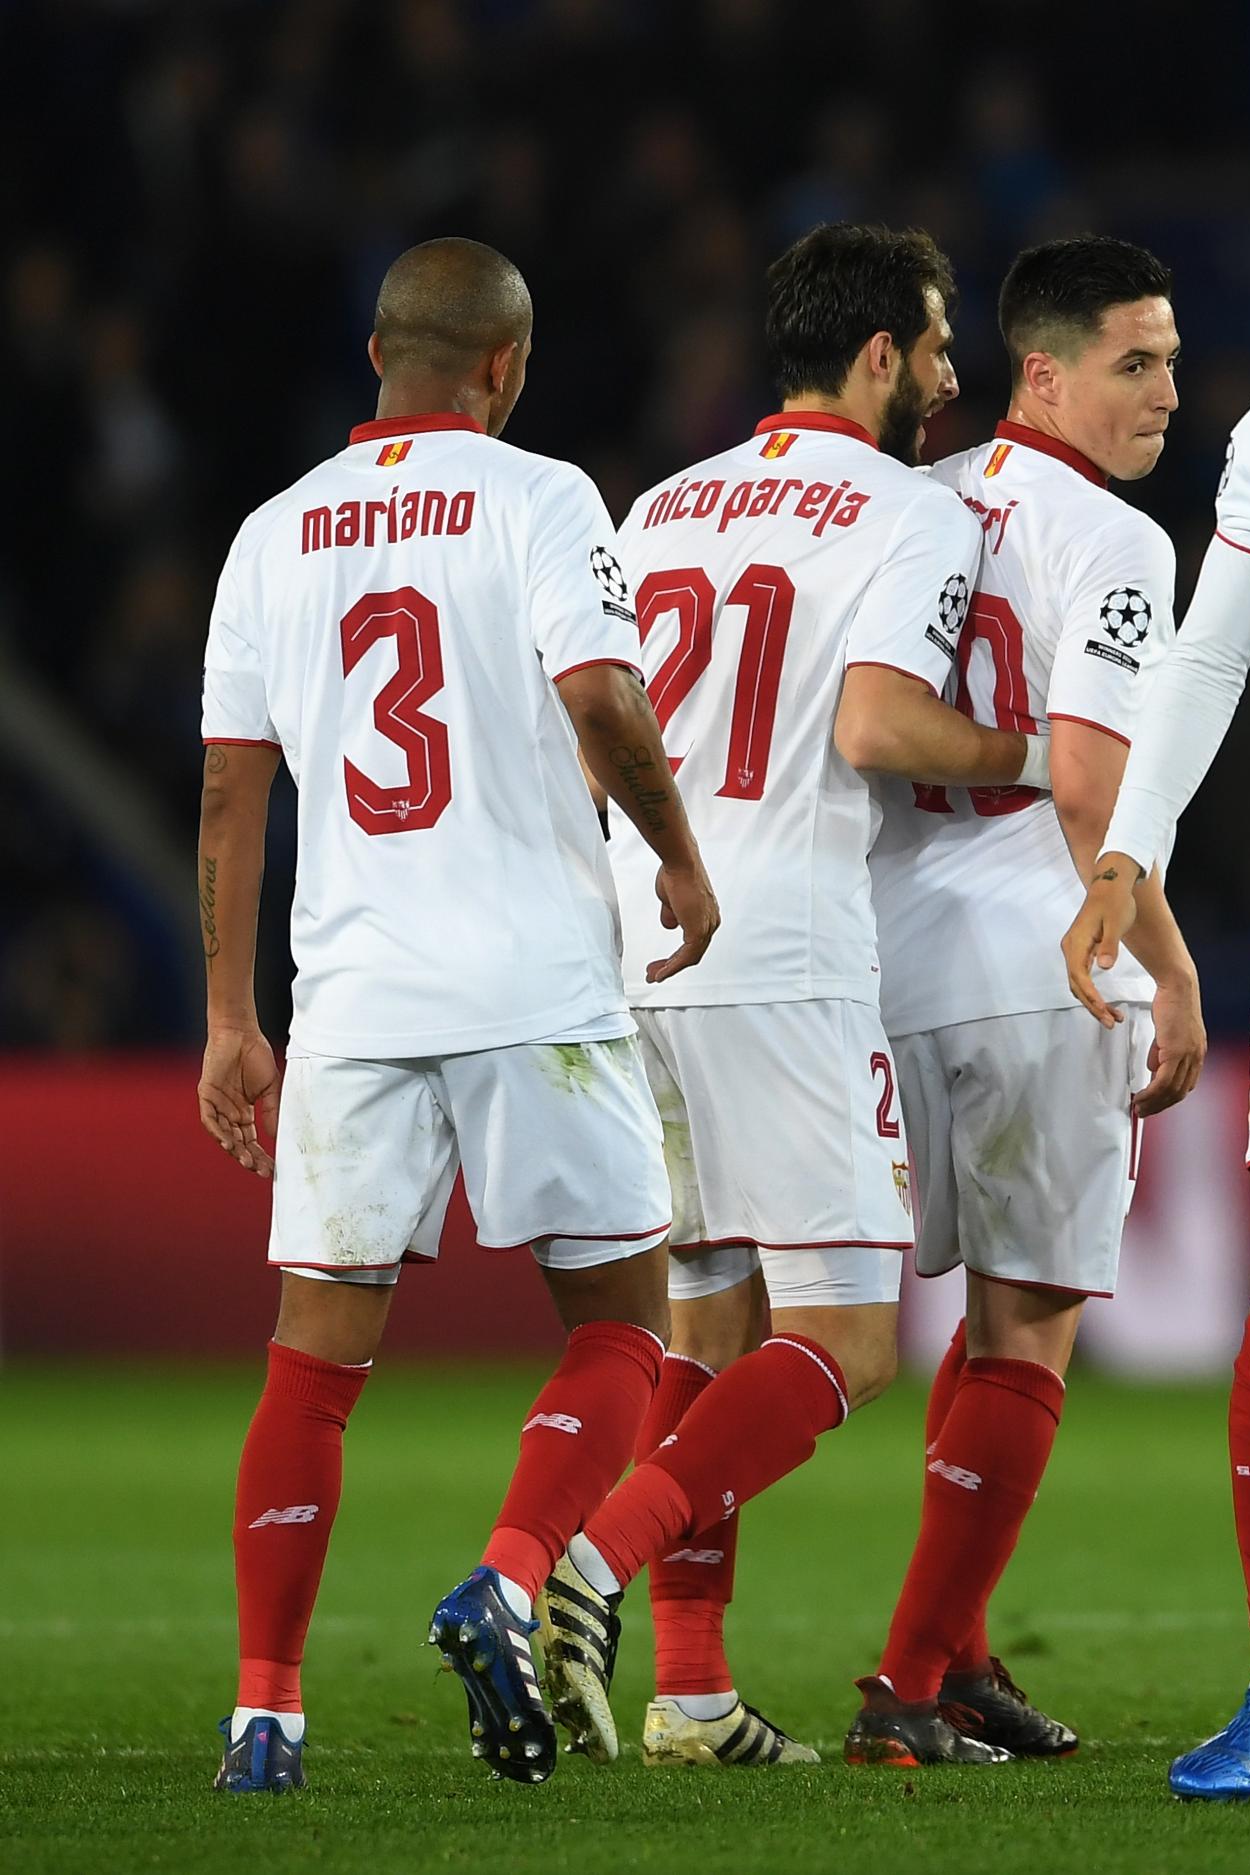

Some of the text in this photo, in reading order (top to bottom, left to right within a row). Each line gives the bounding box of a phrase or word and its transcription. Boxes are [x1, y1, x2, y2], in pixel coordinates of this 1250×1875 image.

[302, 485, 476, 555] mariano
[643, 477, 872, 537] nico pareja
[340, 585, 452, 836] 3
[635, 563, 796, 801] 21
